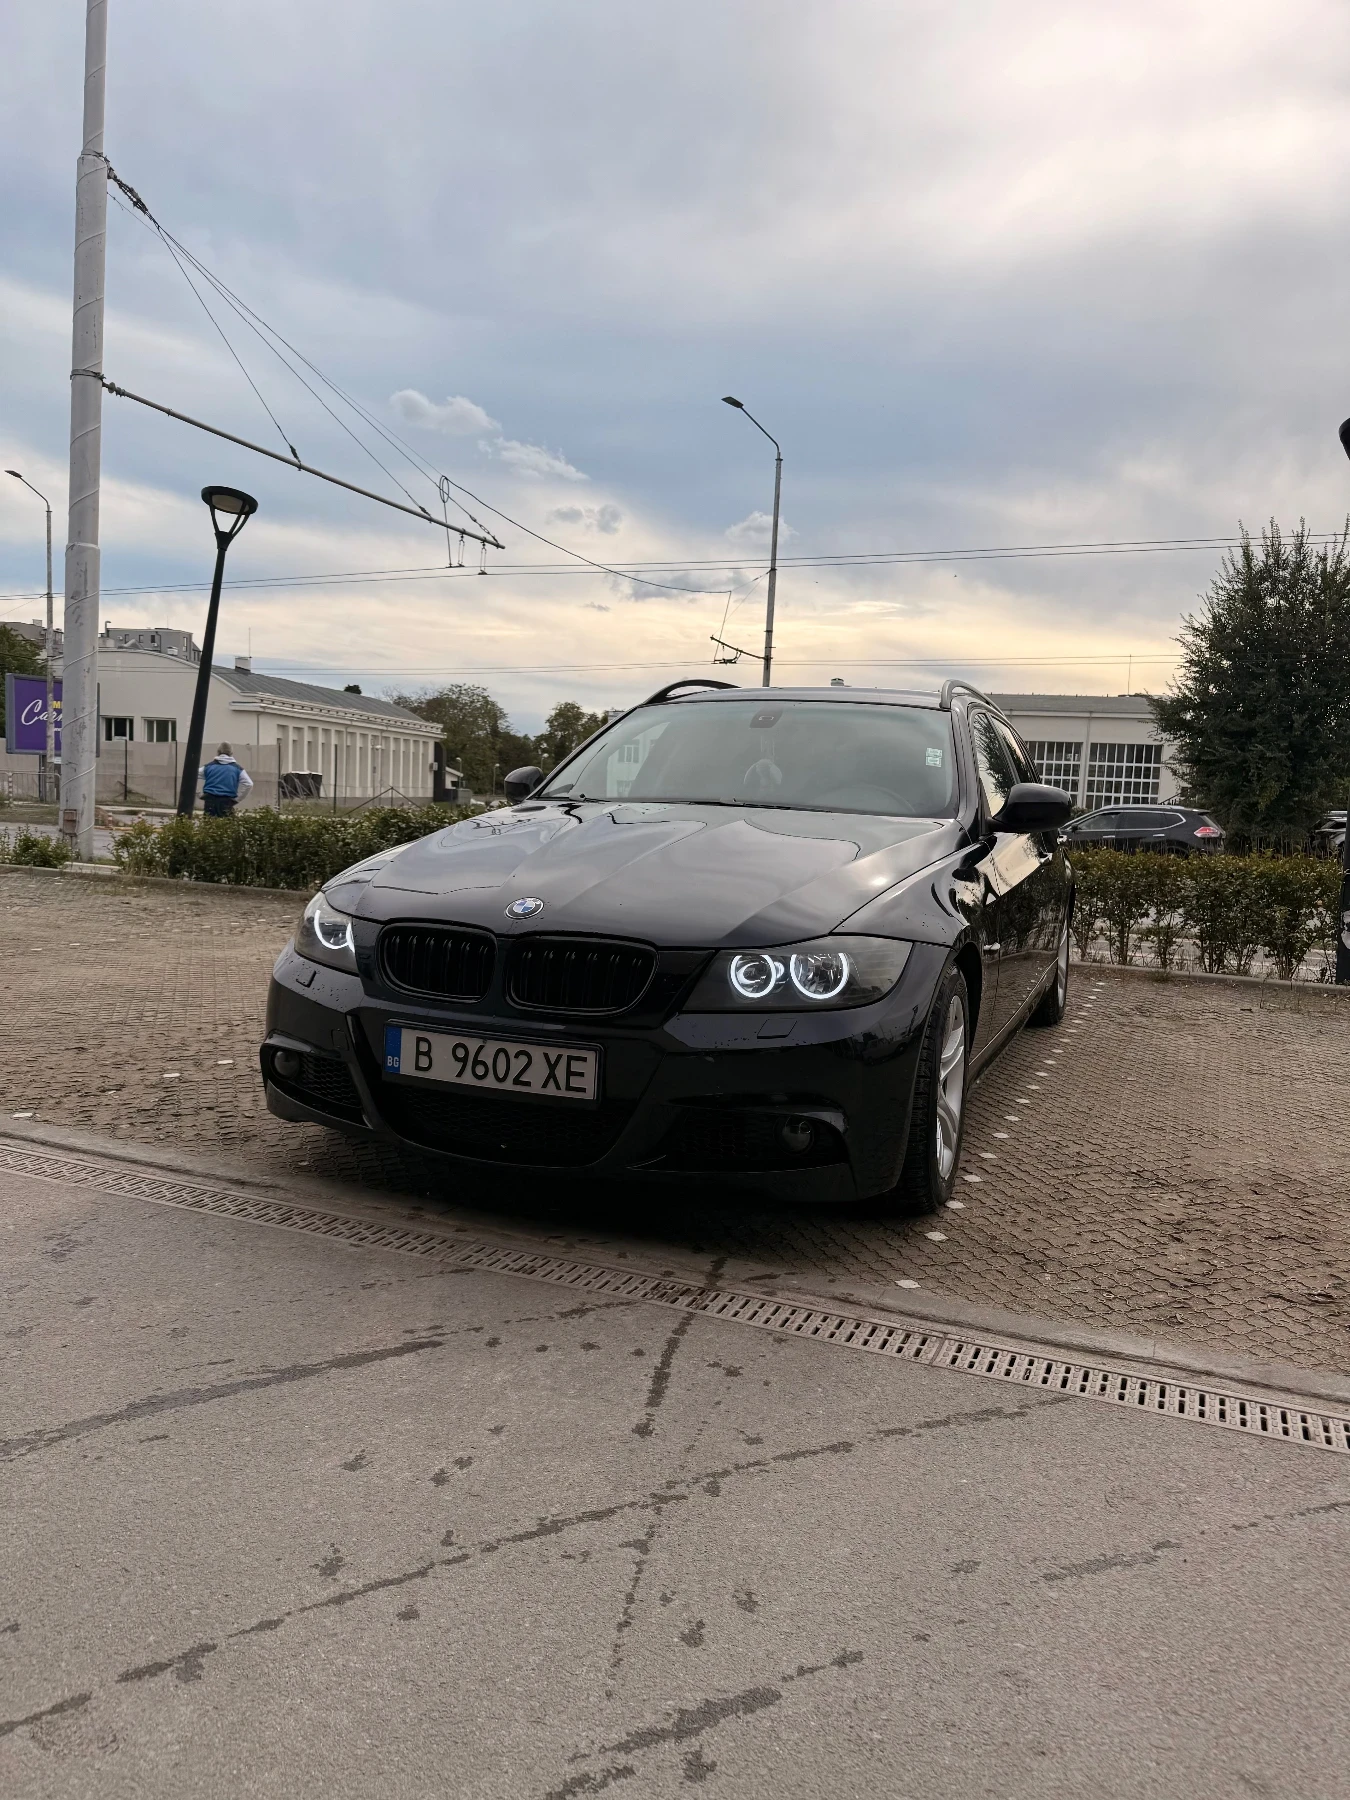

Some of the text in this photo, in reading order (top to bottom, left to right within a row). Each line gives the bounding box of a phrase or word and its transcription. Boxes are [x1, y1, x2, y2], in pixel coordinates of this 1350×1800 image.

[386, 1055, 400, 1068] BG
[414, 1035, 588, 1093] B 9602 XE
